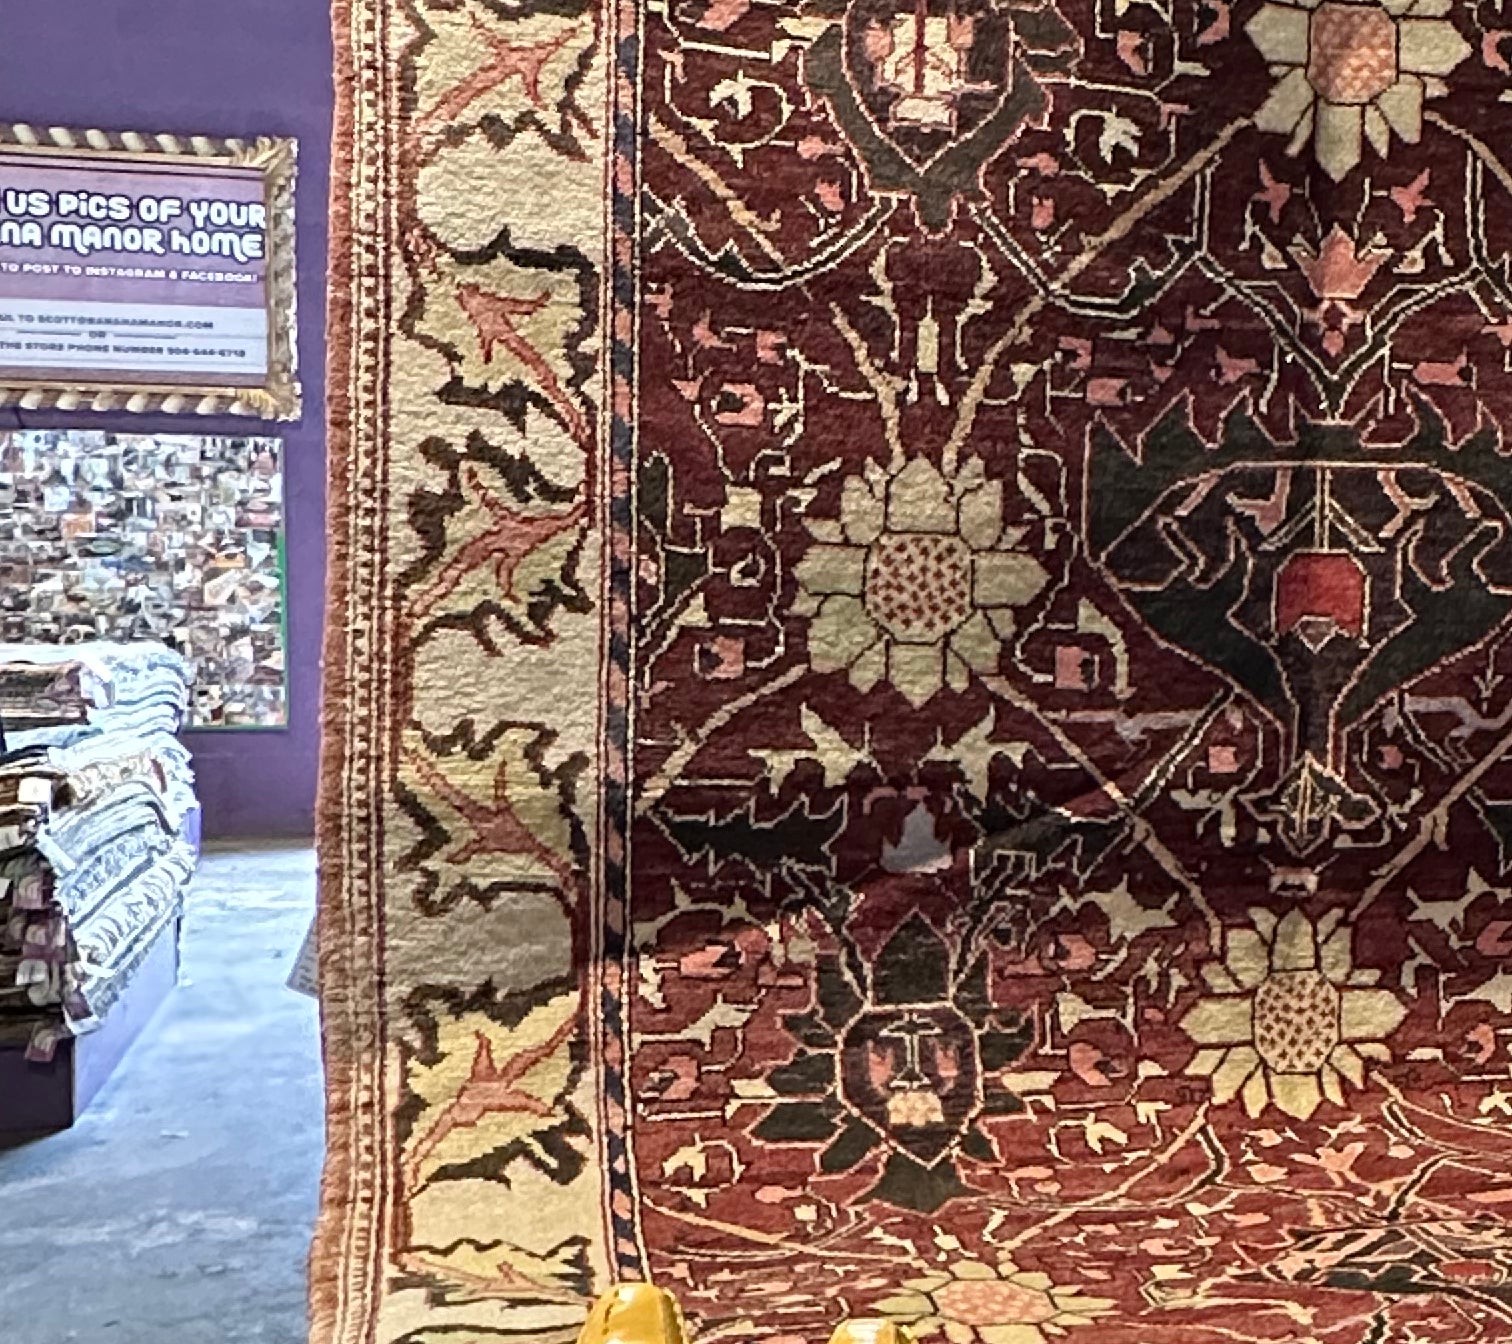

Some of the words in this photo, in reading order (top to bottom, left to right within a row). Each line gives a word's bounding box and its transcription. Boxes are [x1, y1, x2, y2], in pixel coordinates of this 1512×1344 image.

[4, 188, 51, 217] US
[138, 196, 182, 224] OF
[188, 200, 266, 230] YOUR
[49, 222, 166, 256] MANOR
[22, 263, 60, 274] POST
[62, 265, 82, 276] TO
